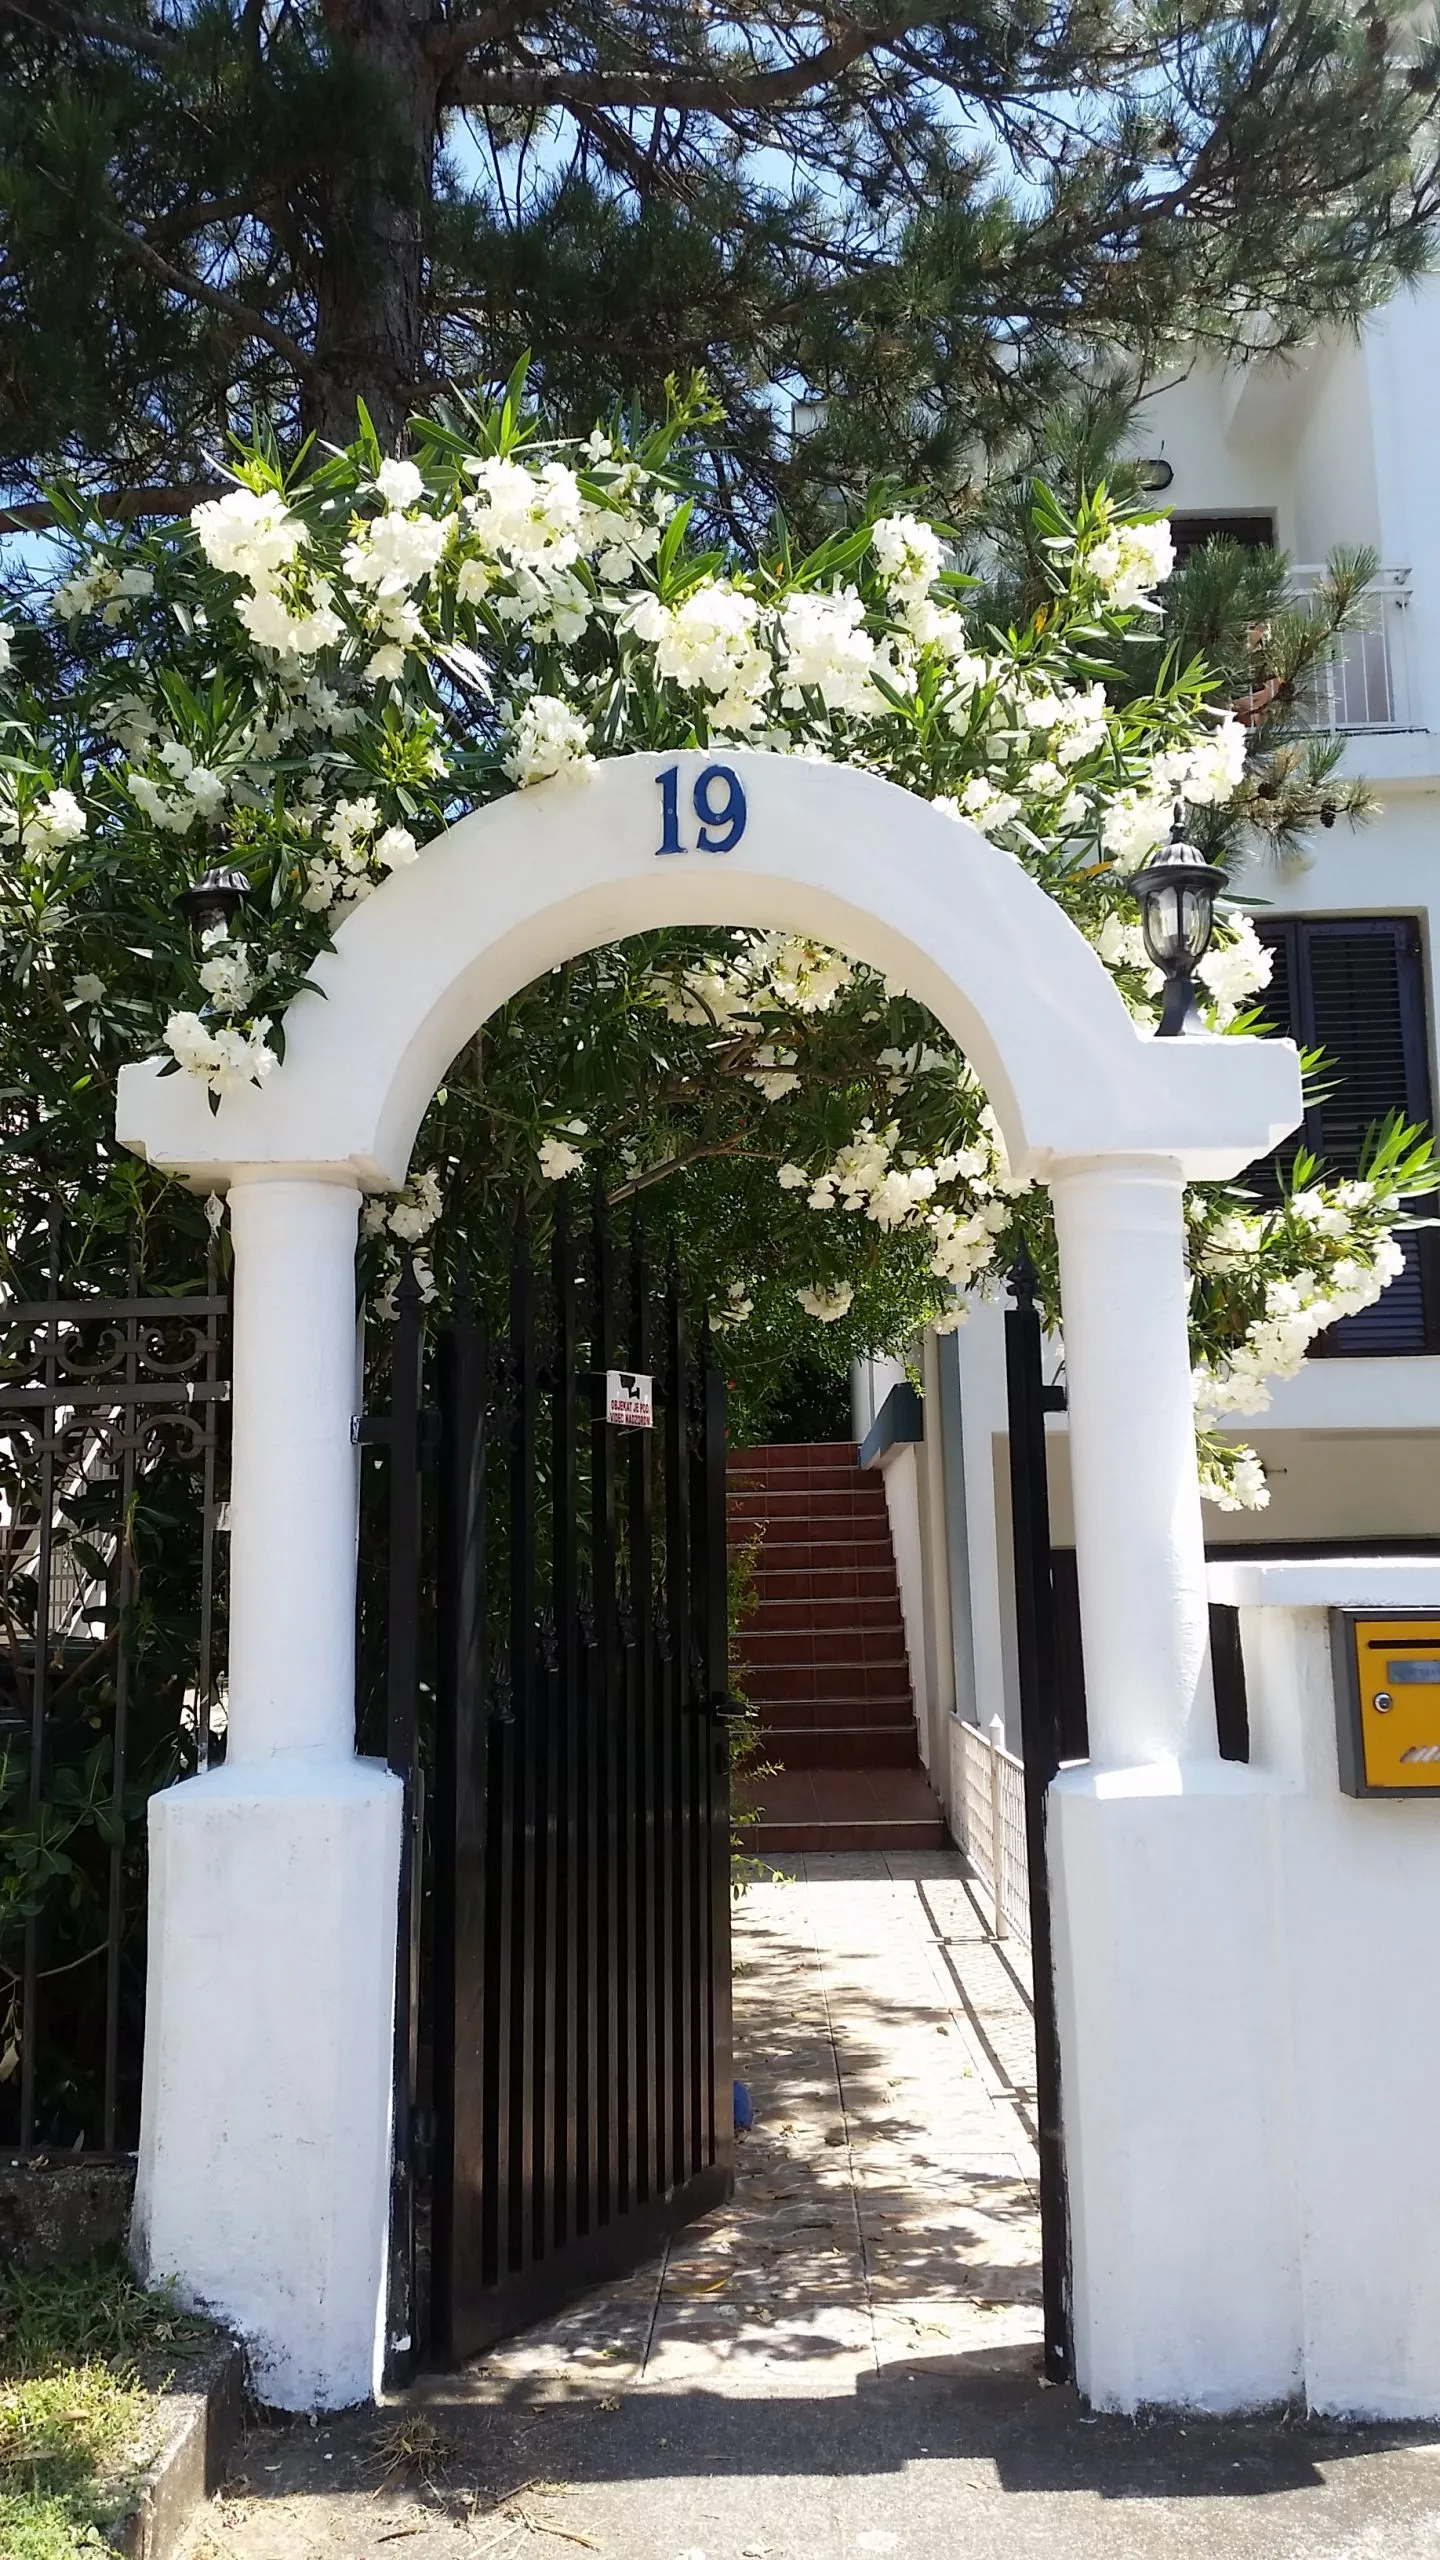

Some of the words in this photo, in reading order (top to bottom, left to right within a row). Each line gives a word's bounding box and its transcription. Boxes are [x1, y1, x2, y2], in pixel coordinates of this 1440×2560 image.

[655, 764, 746, 855] 19
[640, 1403, 649, 1414] POD
[610, 1412, 624, 1423] VIDEO
